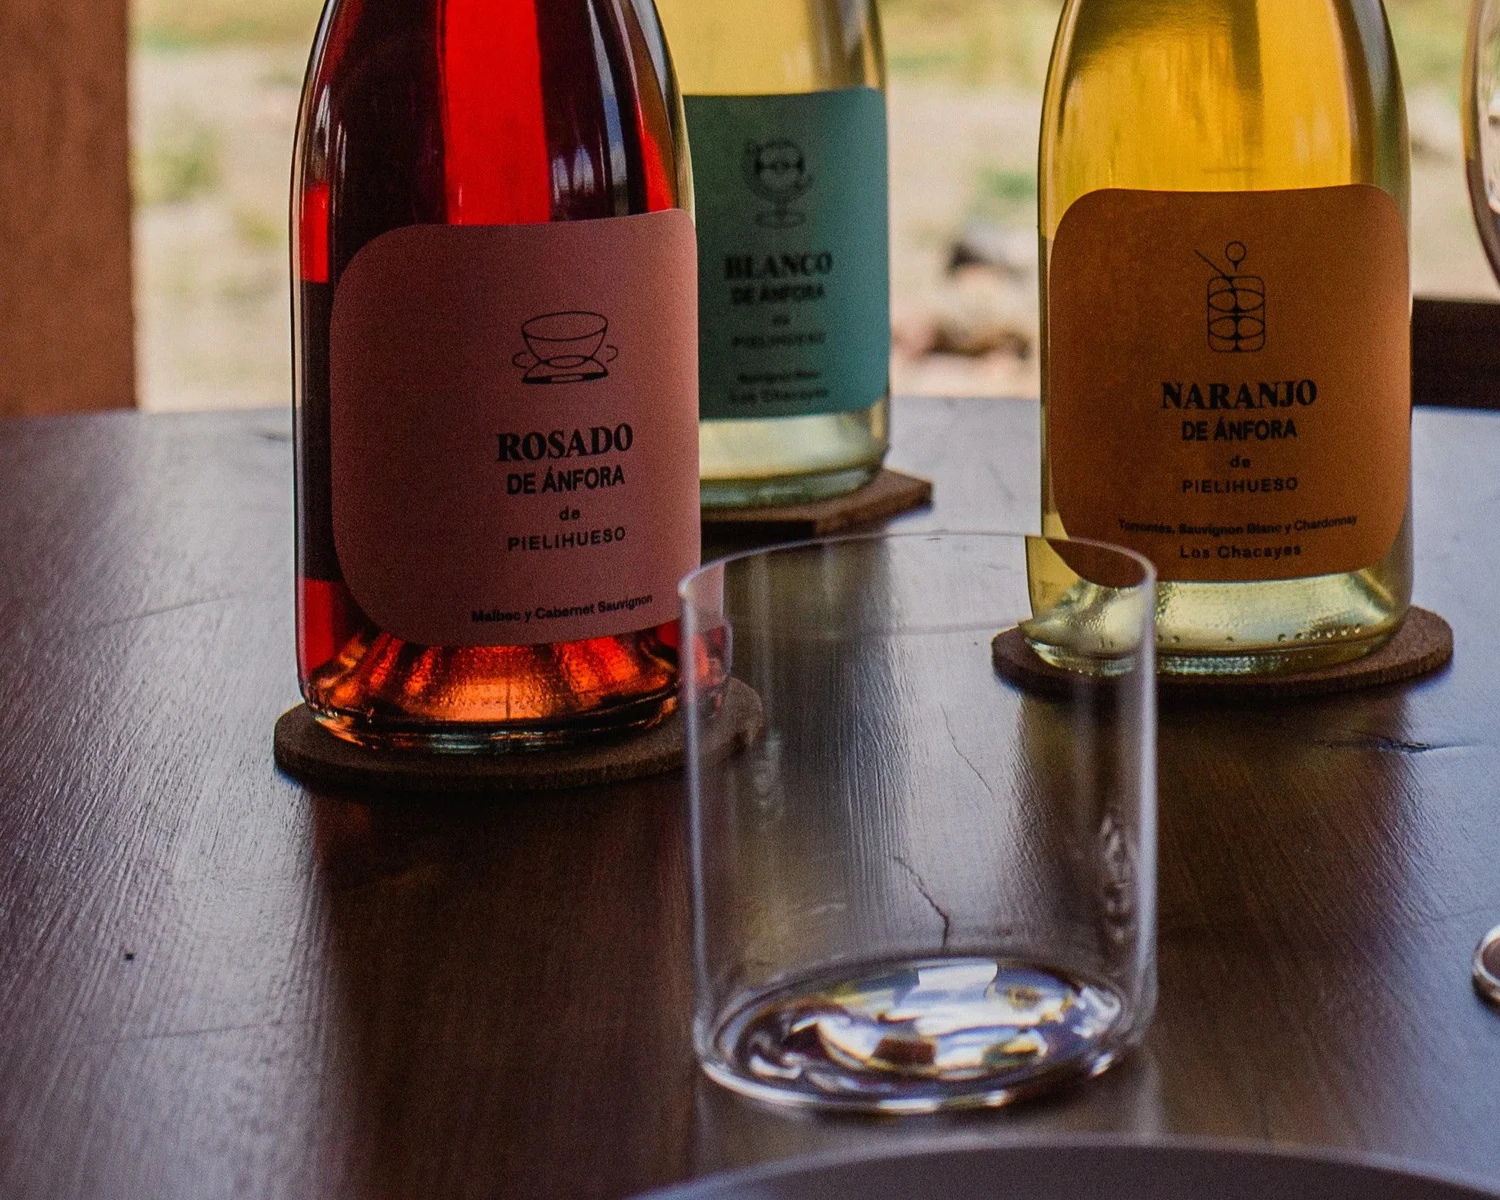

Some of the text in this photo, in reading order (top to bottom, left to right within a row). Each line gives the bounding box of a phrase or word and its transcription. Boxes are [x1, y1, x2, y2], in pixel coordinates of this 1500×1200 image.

[724, 251, 834, 280] BLANCO
[1160, 379, 1318, 411] NARANJO
[1181, 416, 1297, 442] DE ÁNFORA
[496, 423, 634, 462] ROSADO
[1229, 455, 1251, 469] de
[507, 465, 625, 495] DE ÁNFORA
[1182, 477, 1299, 494] PIELIHUESO
[559, 505, 580, 521] de
[1178, 522, 1244, 537] Sauvignon
[1294, 514, 1358, 533] Chardonnay
[507, 526, 626, 552] PIELIHUESO
[1179, 542, 1302, 562] Los Chacayes
[471, 593, 653, 623] Malbec y Cabernet Sauvignon
